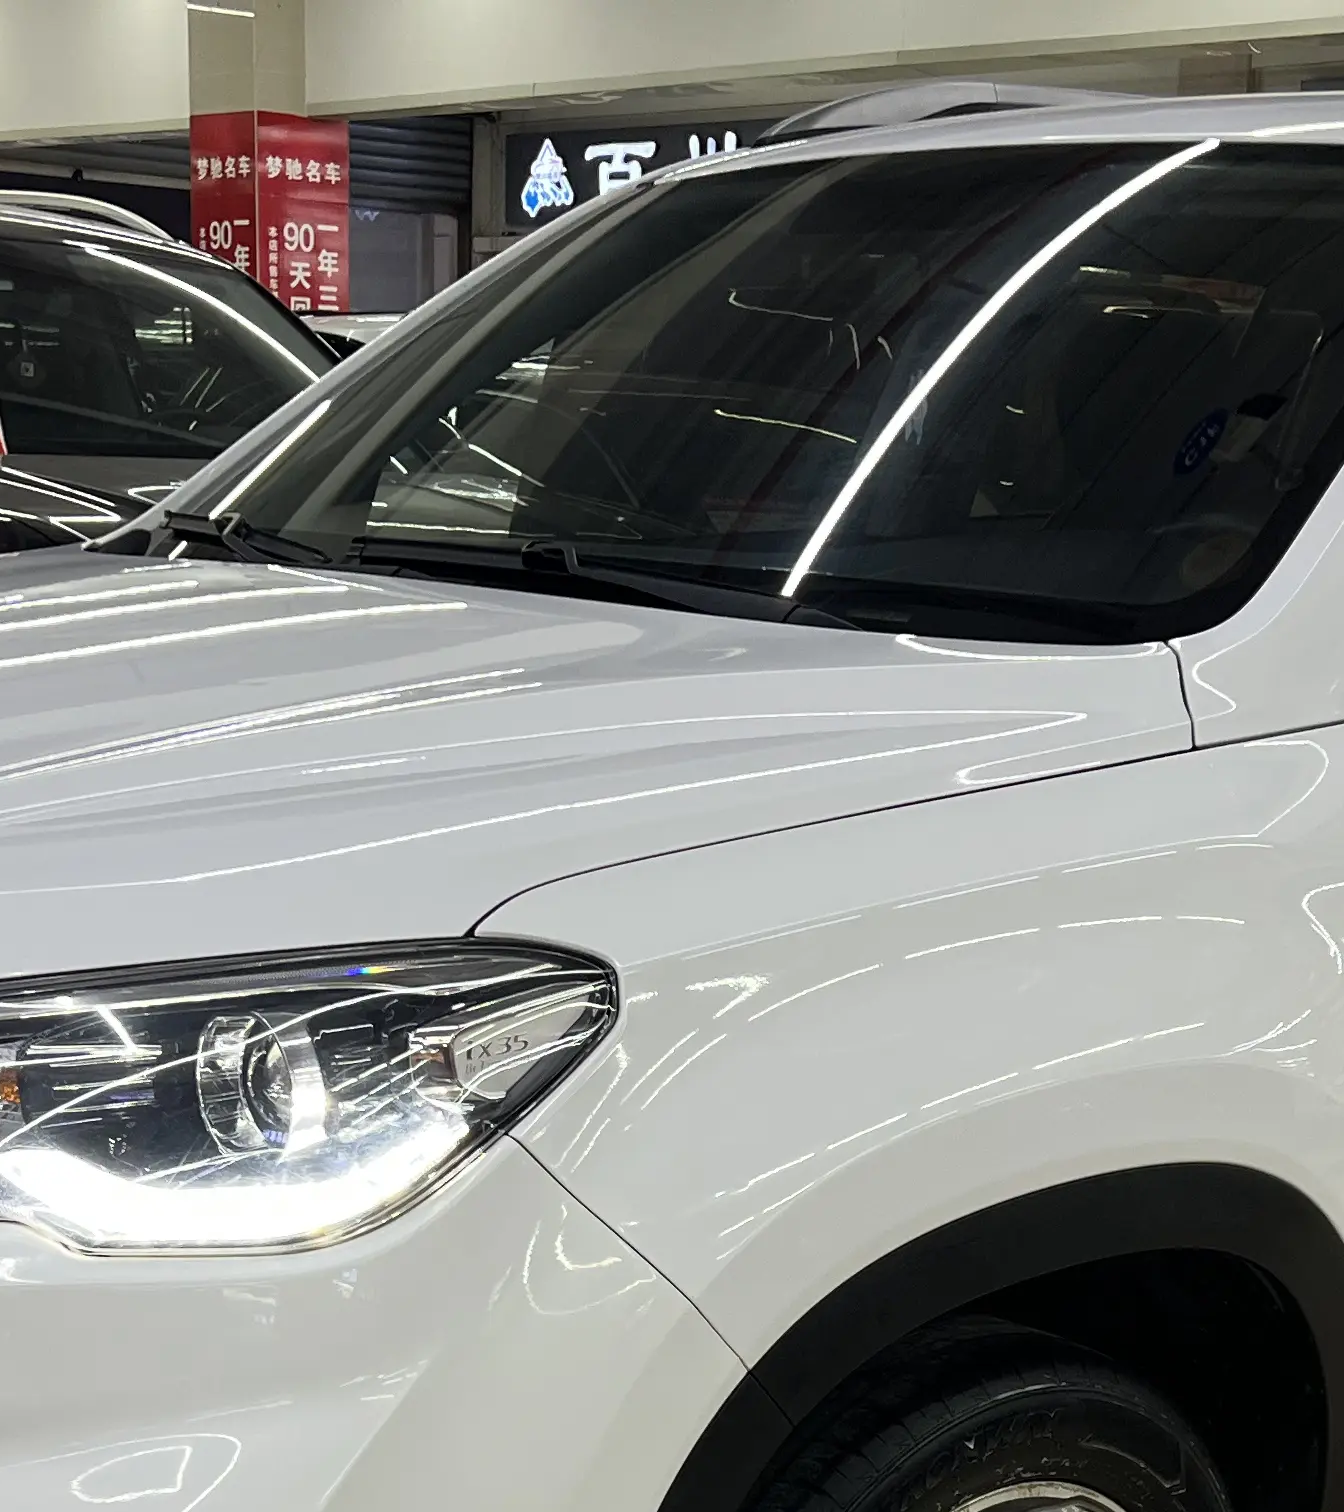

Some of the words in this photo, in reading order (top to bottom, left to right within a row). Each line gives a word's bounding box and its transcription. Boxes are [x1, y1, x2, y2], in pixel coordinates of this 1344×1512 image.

[196, 155, 251, 180] 梦驰名车
[266, 155, 341, 185] 梦驰名车
